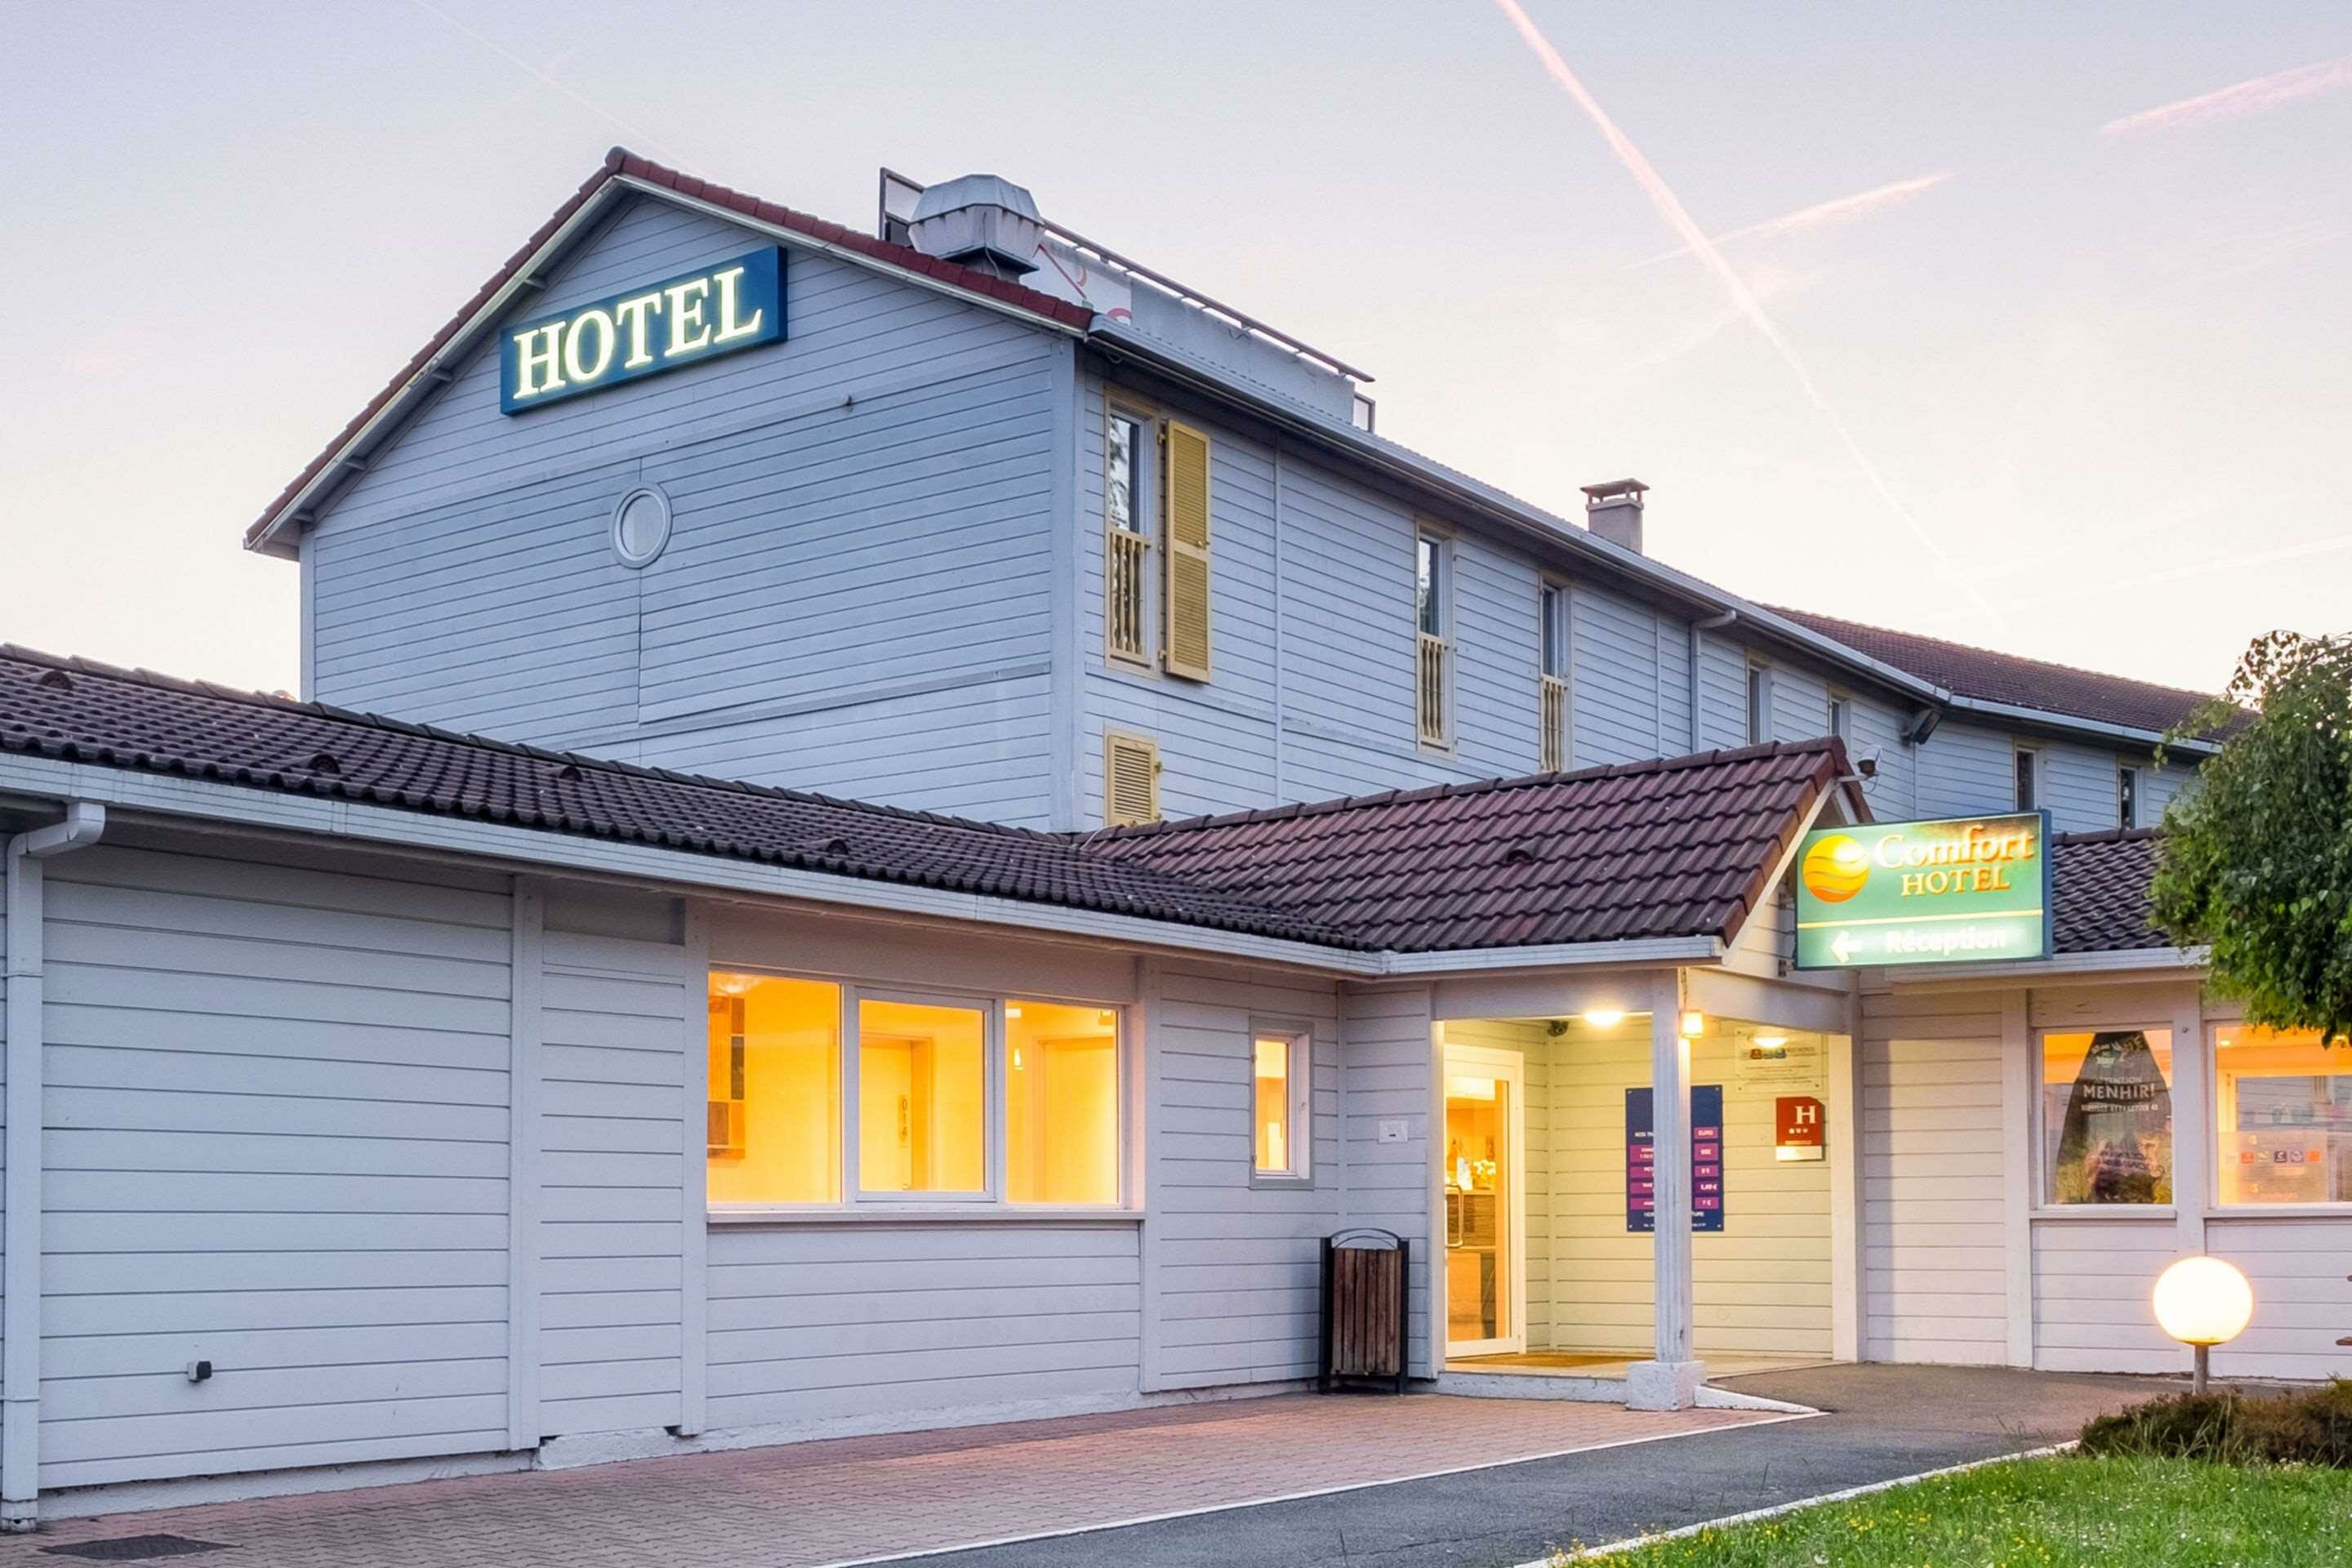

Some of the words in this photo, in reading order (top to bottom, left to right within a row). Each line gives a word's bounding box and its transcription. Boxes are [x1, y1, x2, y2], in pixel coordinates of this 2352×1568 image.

[513, 266, 763, 399] HOTEL
[1875, 824, 2035, 870] Comfort
[1901, 867, 2011, 897] HOTEL
[1886, 925, 2007, 956] Réception
[2083, 1083, 2155, 1099] MENHIR!
[1795, 1105, 1816, 1125] H
